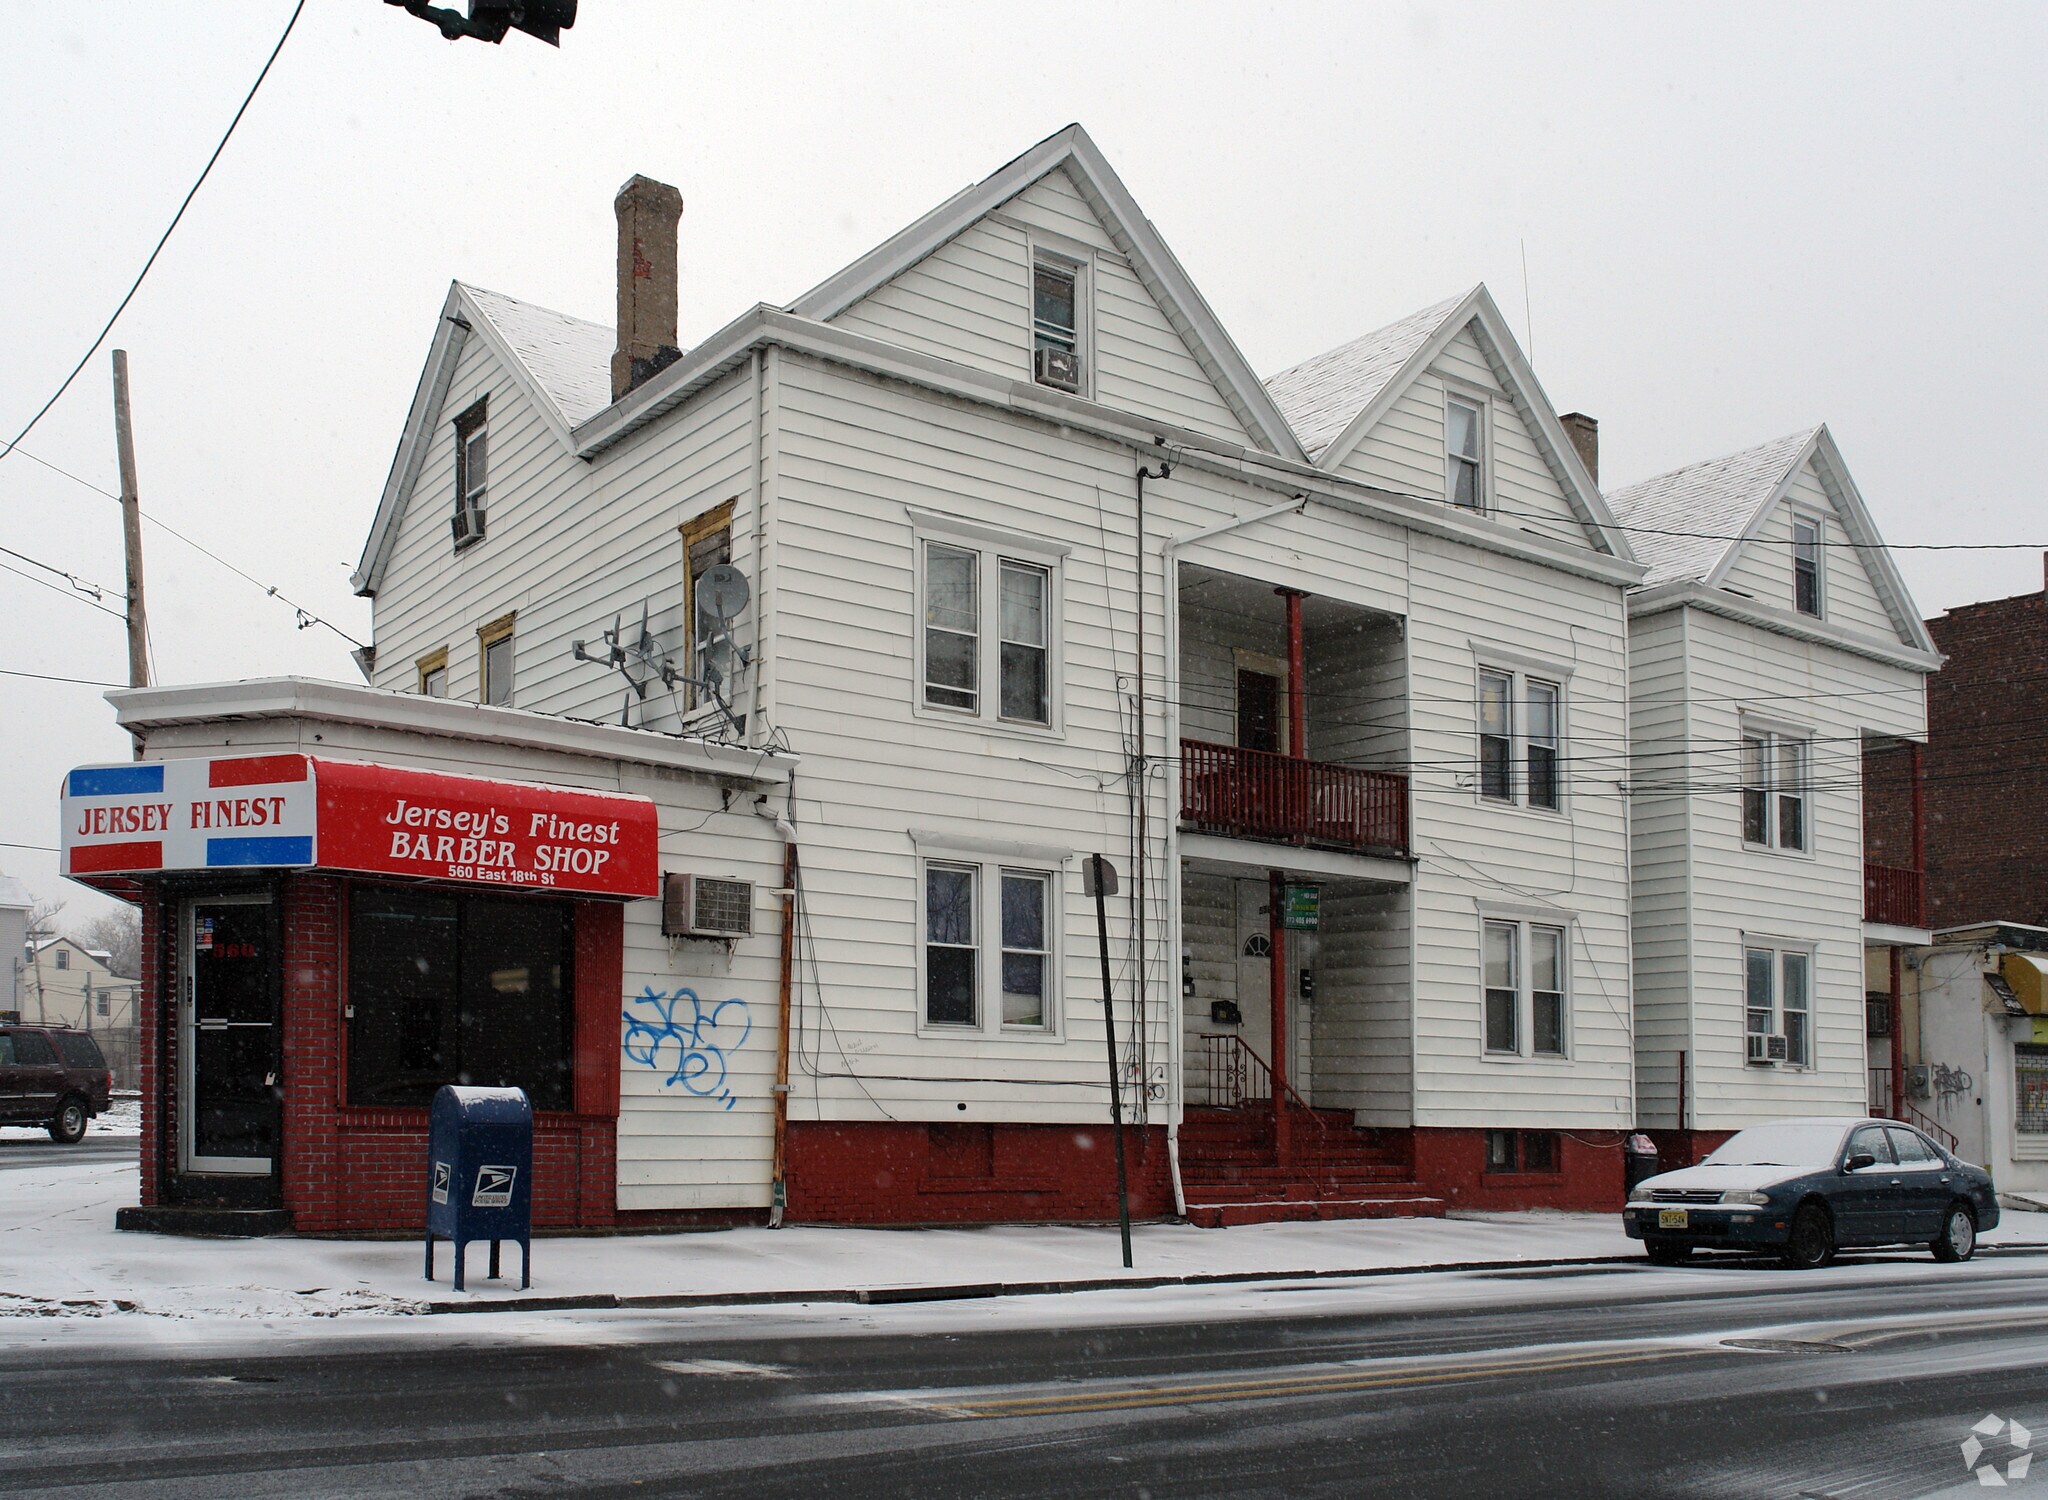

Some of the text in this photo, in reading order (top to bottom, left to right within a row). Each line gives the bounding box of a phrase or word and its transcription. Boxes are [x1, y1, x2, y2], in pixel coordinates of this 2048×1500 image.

[78, 797, 286, 836] JERSEY FINEST
[385, 800, 620, 845] Jersey's Finest
[389, 831, 610, 875] BARBER SHOP
[448, 864, 555, 885] 560 East 18th St
[213, 943, 255, 959] 560
